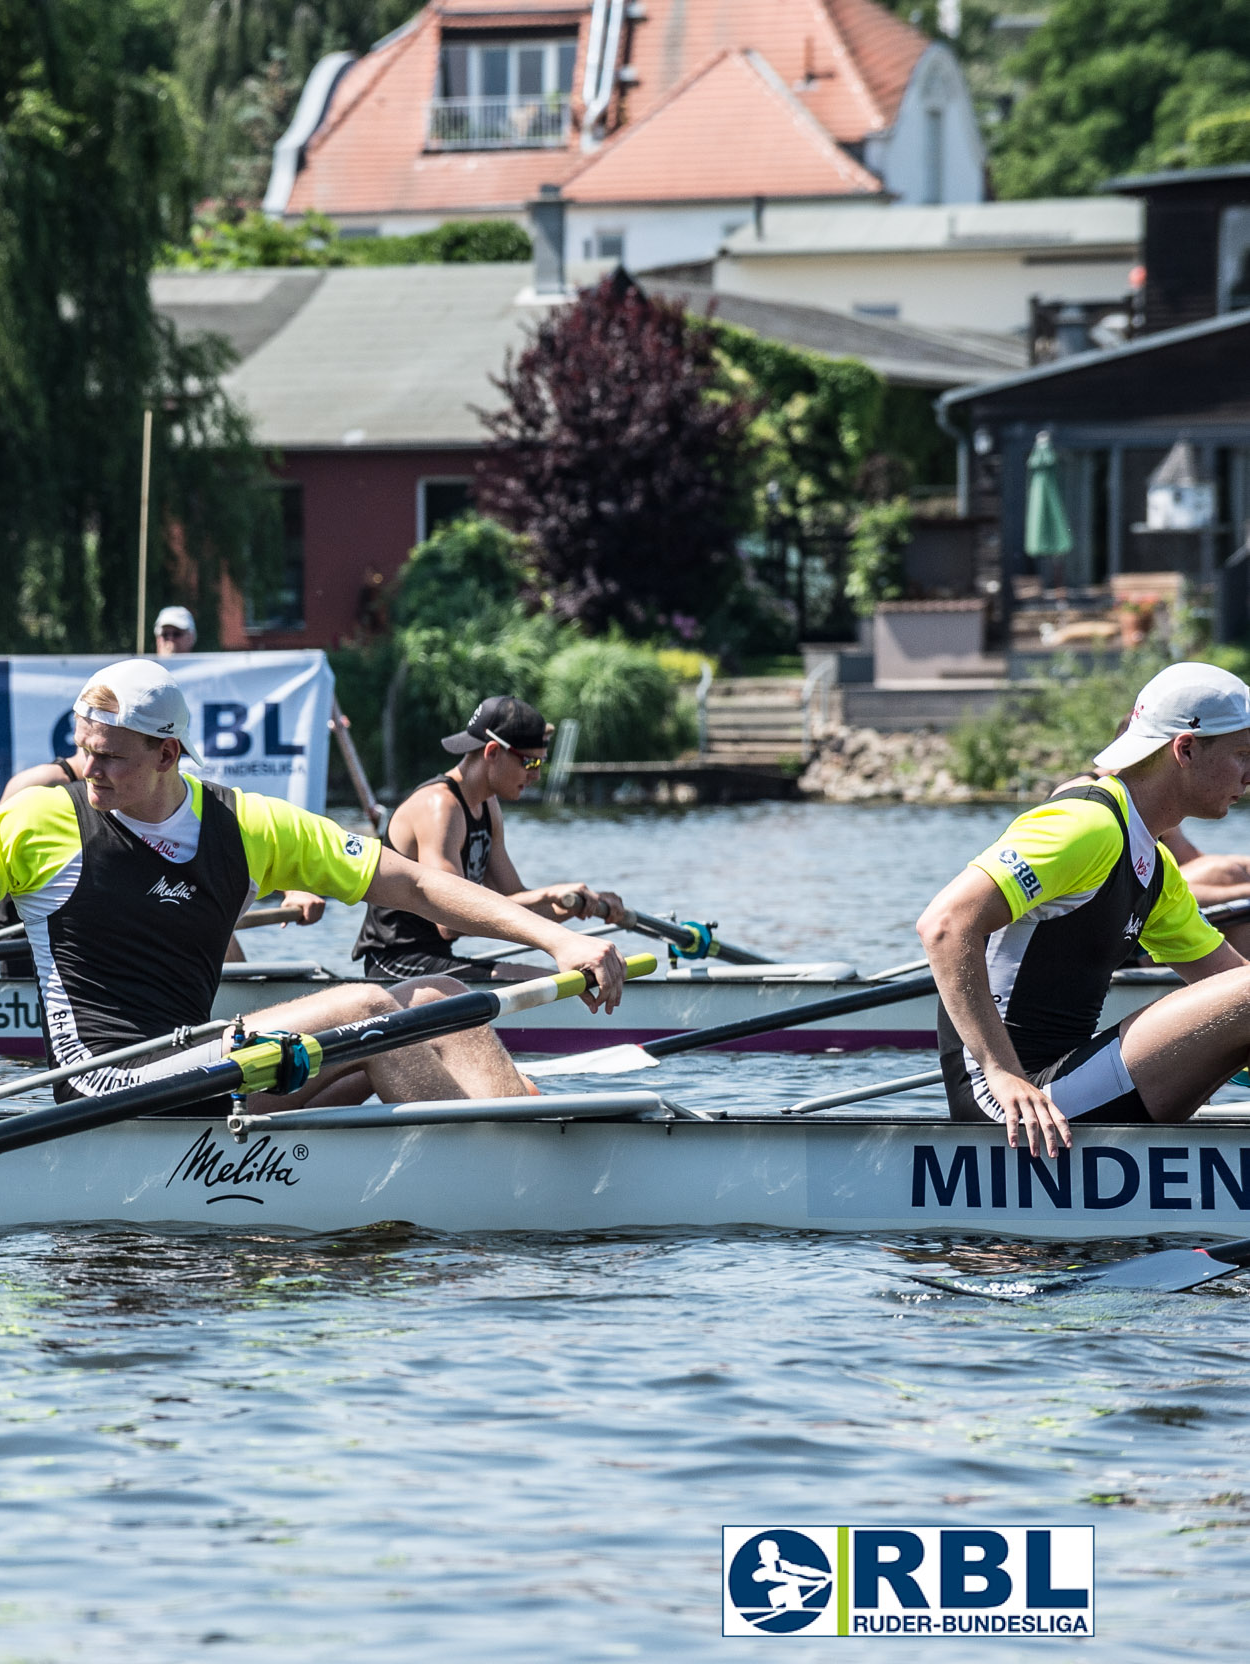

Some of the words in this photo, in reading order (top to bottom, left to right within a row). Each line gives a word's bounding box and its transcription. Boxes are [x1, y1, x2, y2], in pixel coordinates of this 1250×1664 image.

[203, 703, 305, 757] BL
[1012, 860, 1042, 899] RBL
[911, 1145, 1250, 1210] MINDEN
